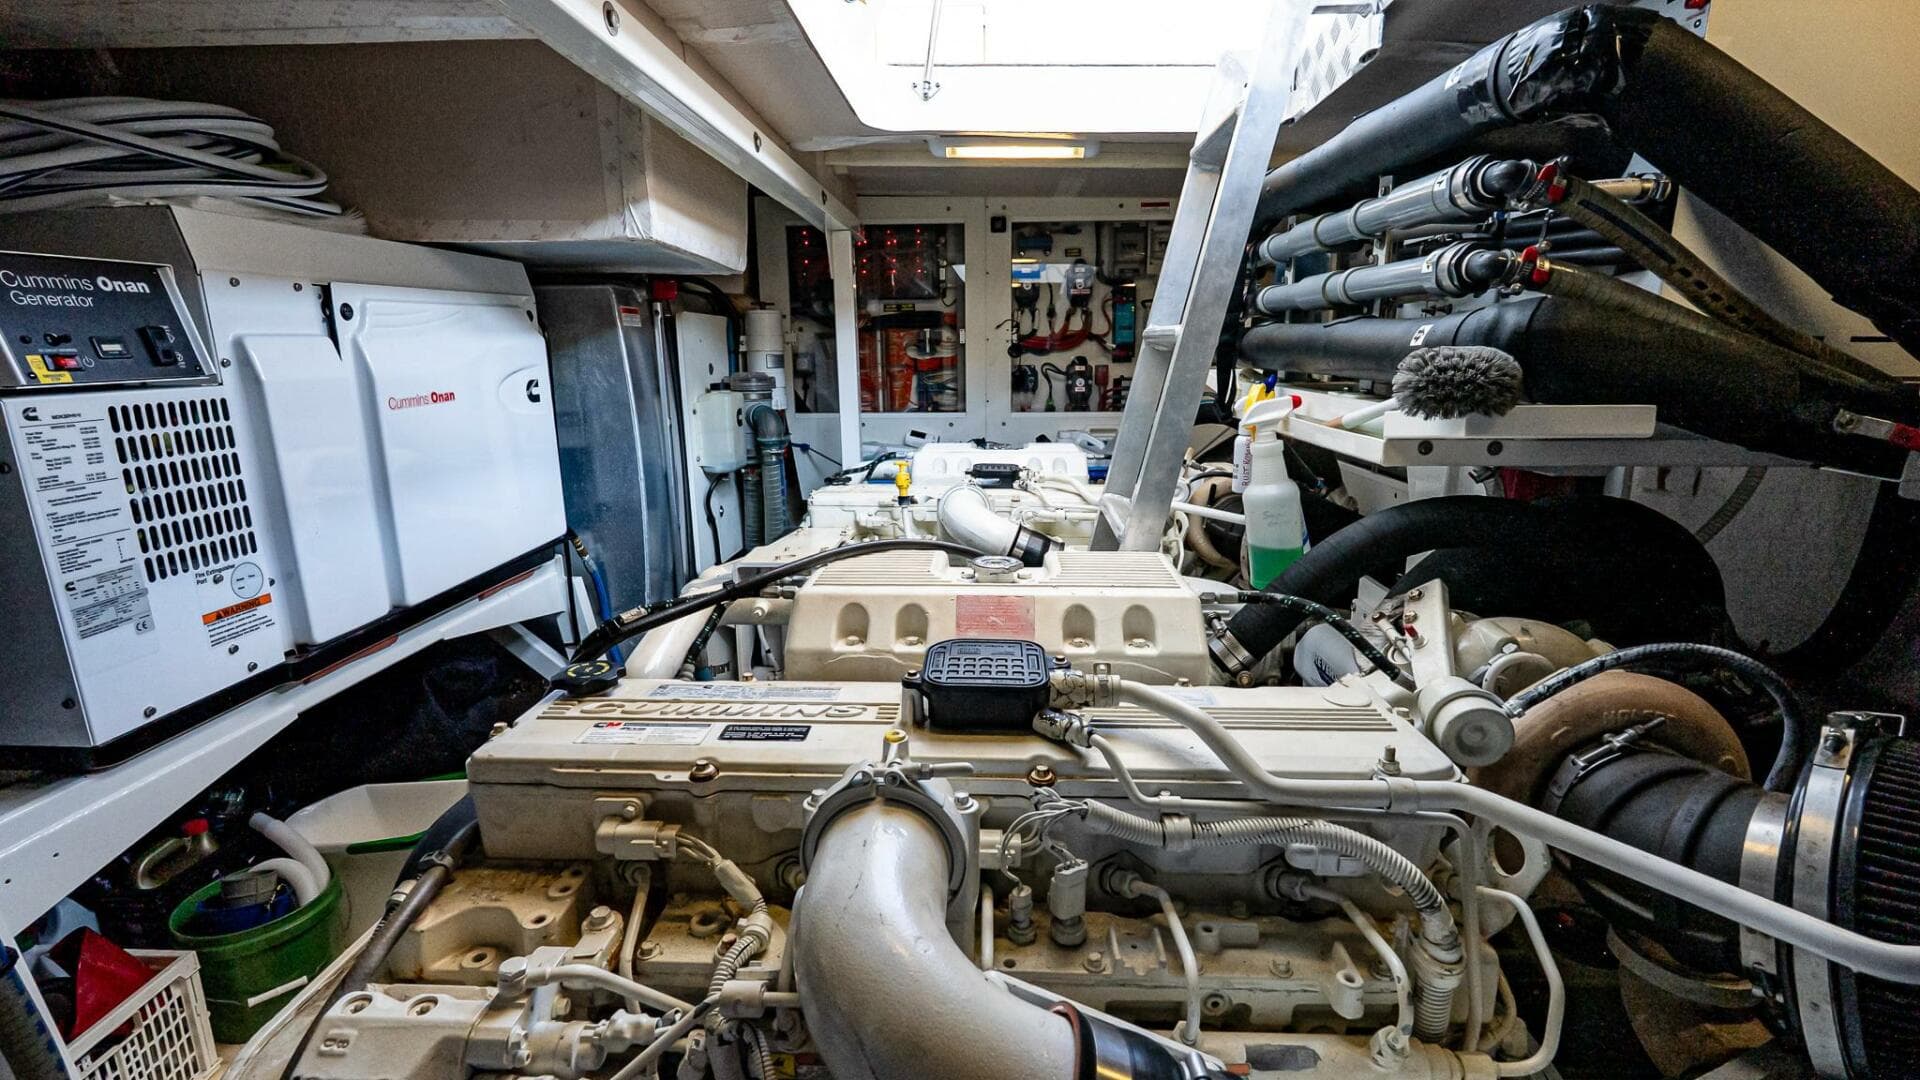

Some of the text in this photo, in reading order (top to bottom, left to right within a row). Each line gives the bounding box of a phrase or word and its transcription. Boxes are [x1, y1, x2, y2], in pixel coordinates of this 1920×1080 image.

[0, 270, 150, 293] Cummins Onan
[10, 290, 94, 307] Generator
[389, 391, 455, 409] Cummins Onan
[221, 597, 261, 618] WARNING
[580, 701, 867, 717] CUMMINS
